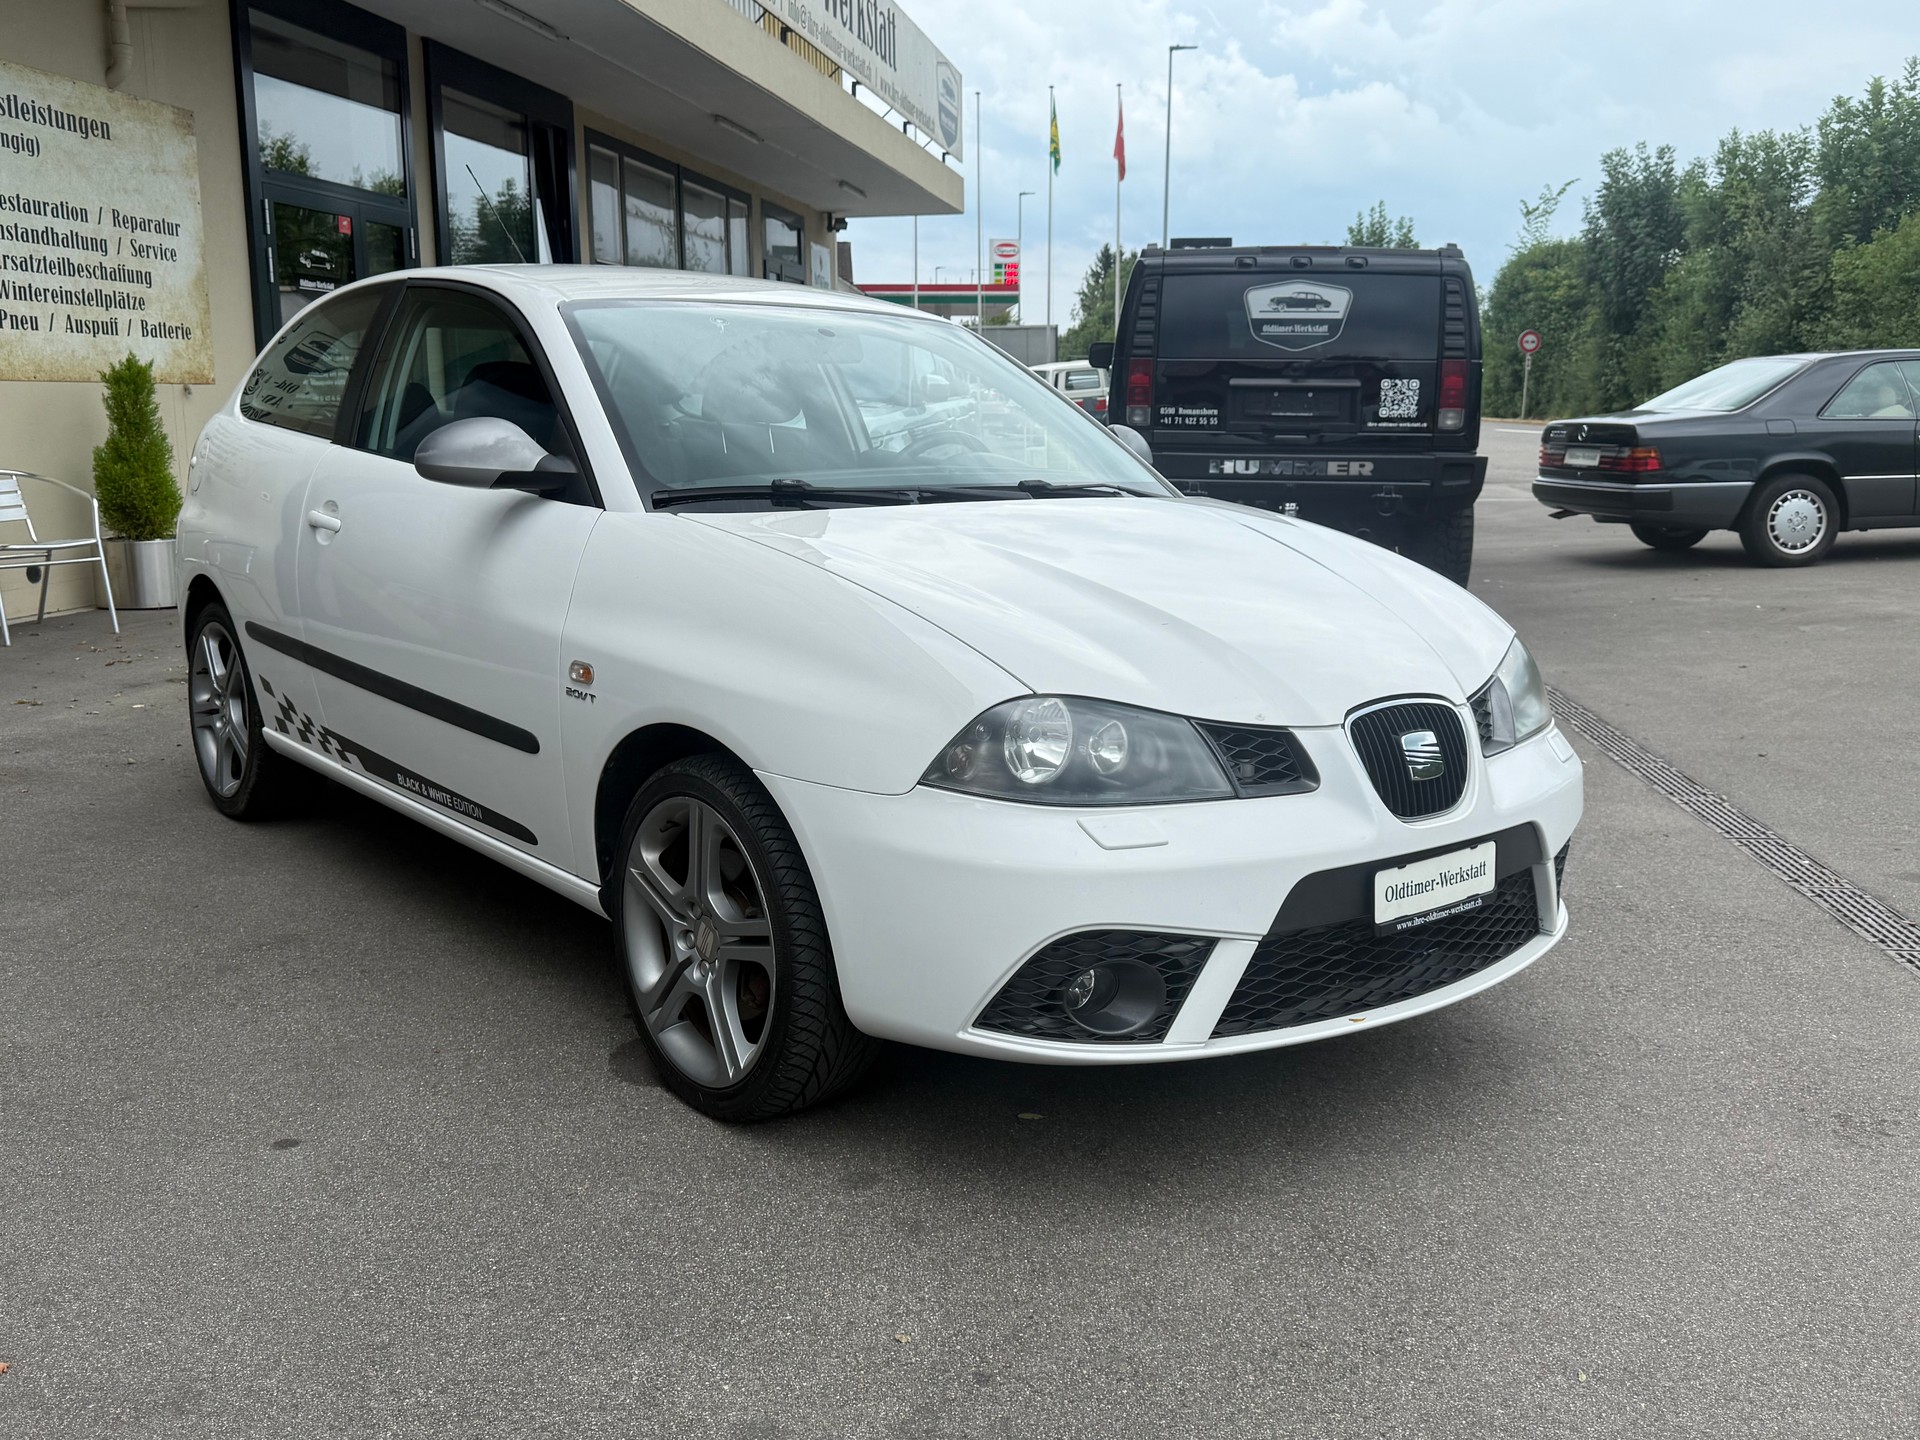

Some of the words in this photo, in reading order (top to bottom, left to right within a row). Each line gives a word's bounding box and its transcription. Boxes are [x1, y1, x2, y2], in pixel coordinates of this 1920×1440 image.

[824, 0, 896, 72] erkstatt
[0, 94, 111, 140] stleistungen
[0, 132, 40, 157] ngig)
[0, 193, 89, 223] estauration
[112, 208, 181, 237] Reparatur
[130, 238, 177, 262] Service
[0, 253, 152, 288] rsatzteilbeschaffung
[0, 279, 146, 311] Wintereinstellplätze
[0, 308, 39, 331] Pneu
[65, 314, 119, 337] Auspuff
[141, 319, 192, 340] Batterie
[1160, 417, 1172, 425] +41
[1199, 417, 1208, 425] 55
[1209, 417, 1218, 425] 55
[1178, 407, 1219, 416] Romanshorn
[1209, 459, 1374, 476] HUMMER
[397, 773, 421, 792] BLACK
[421, 783, 428, 795] &
[428, 786, 452, 807] WHITE
[453, 796, 483, 820] EDITION
[1385, 861, 1487, 902] Oldtimer-Werkstatt
[1396, 898, 1483, 931] www.ihre-oldtimer-werkstatt.ch
